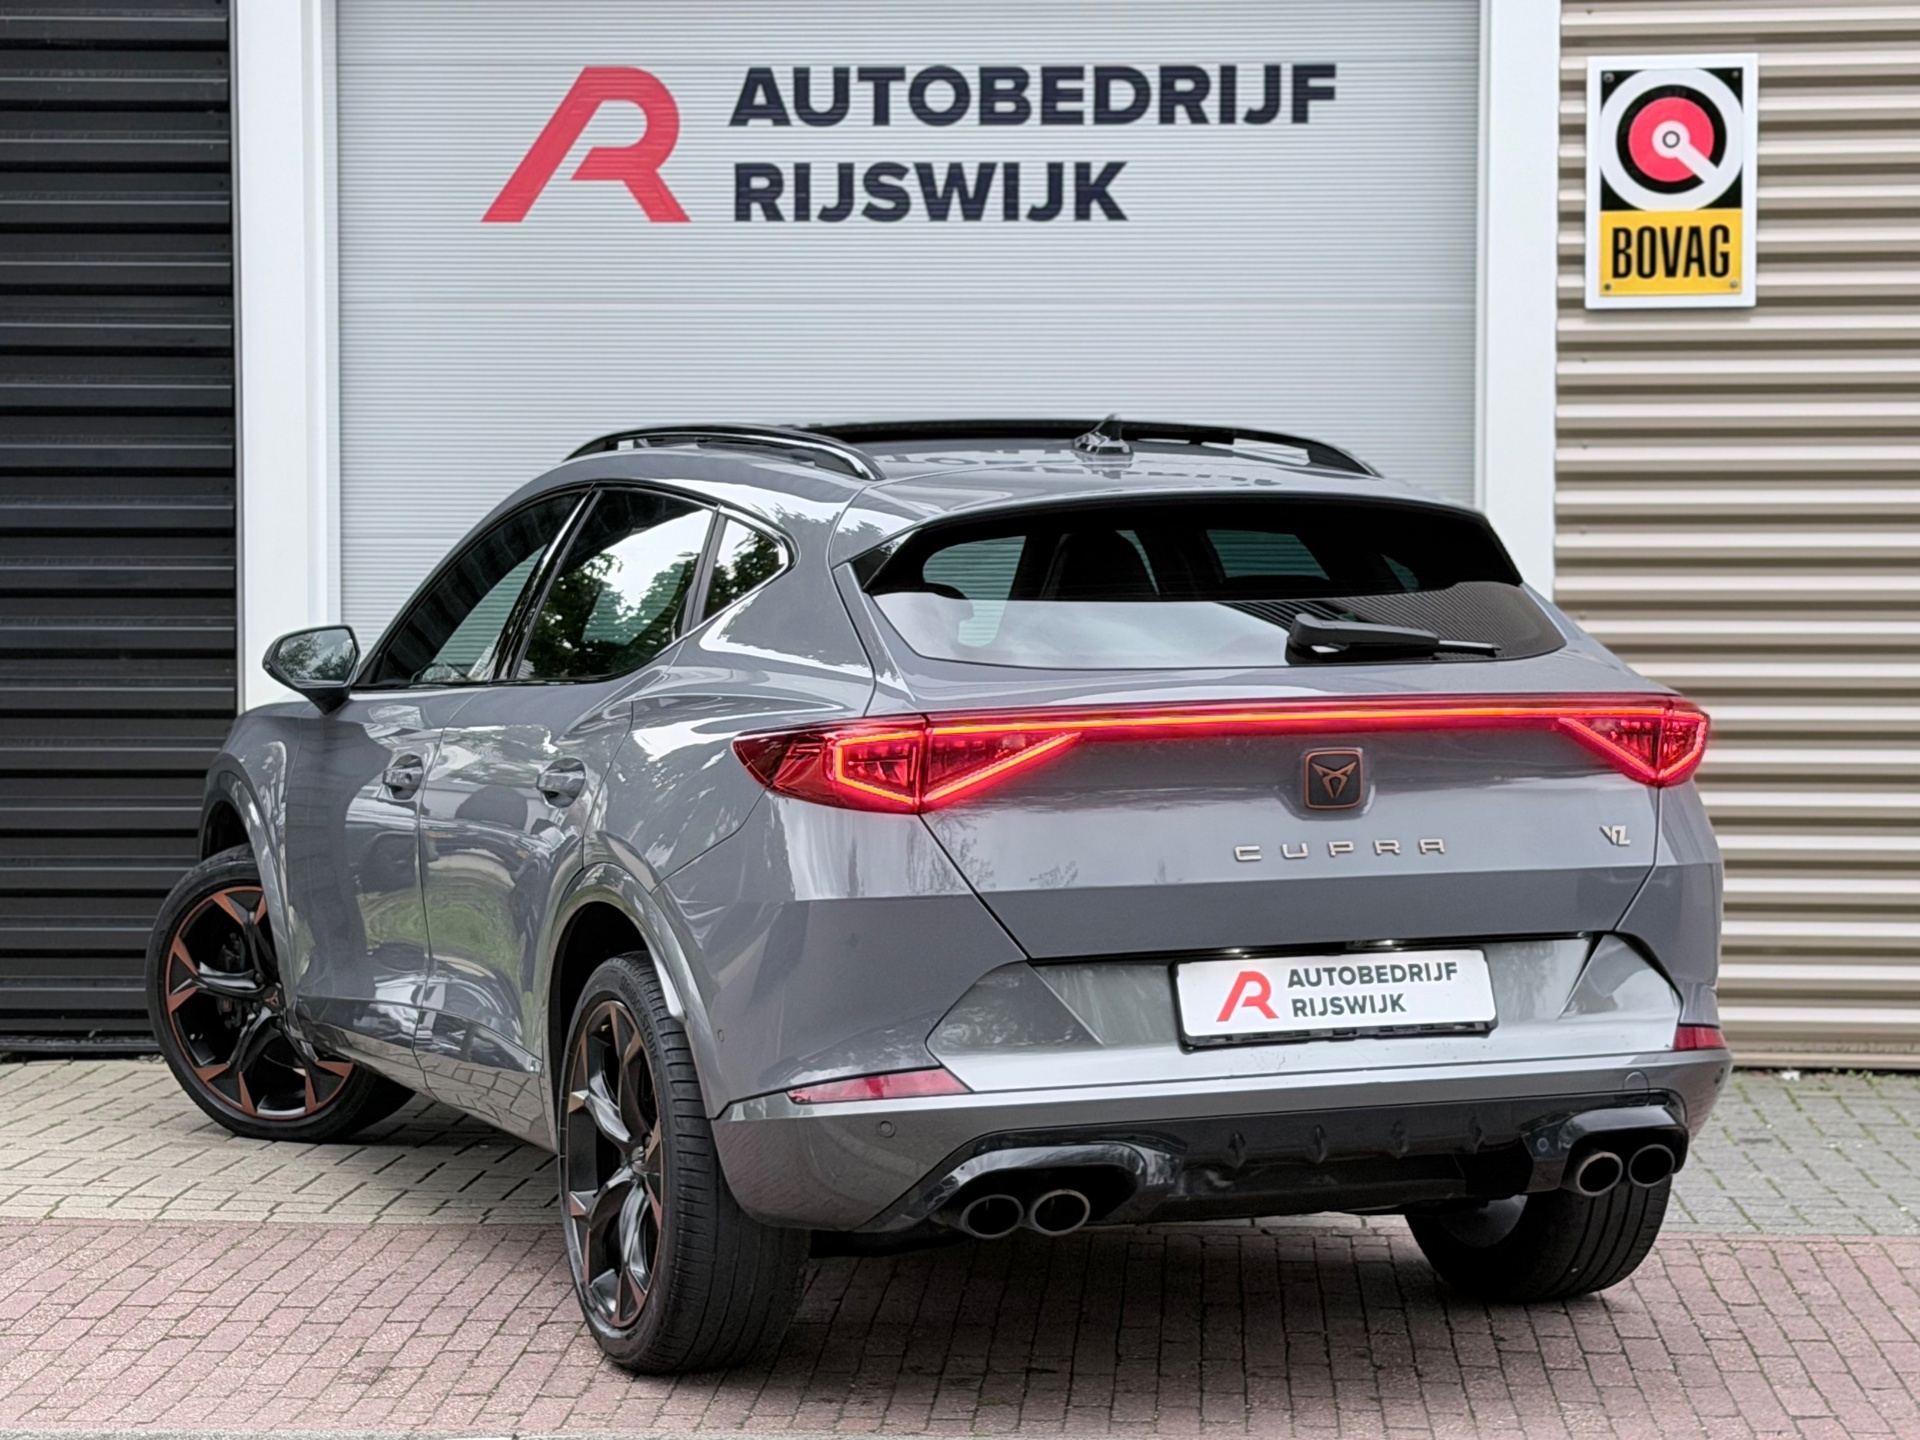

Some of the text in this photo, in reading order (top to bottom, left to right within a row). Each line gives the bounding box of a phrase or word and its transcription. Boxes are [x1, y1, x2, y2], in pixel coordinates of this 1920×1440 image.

[729, 63, 1336, 127] AUTOBEDRIJF
[734, 161, 1128, 223] RIJSWIJK
[1612, 224, 1730, 279] BOVAG
[1599, 824, 1631, 847] VZ
[1234, 838, 1446, 862] CUPRA
[1287, 962, 1458, 988] AUTOBEDRIJF
[1291, 993, 1407, 1018] RIJSWIJK
